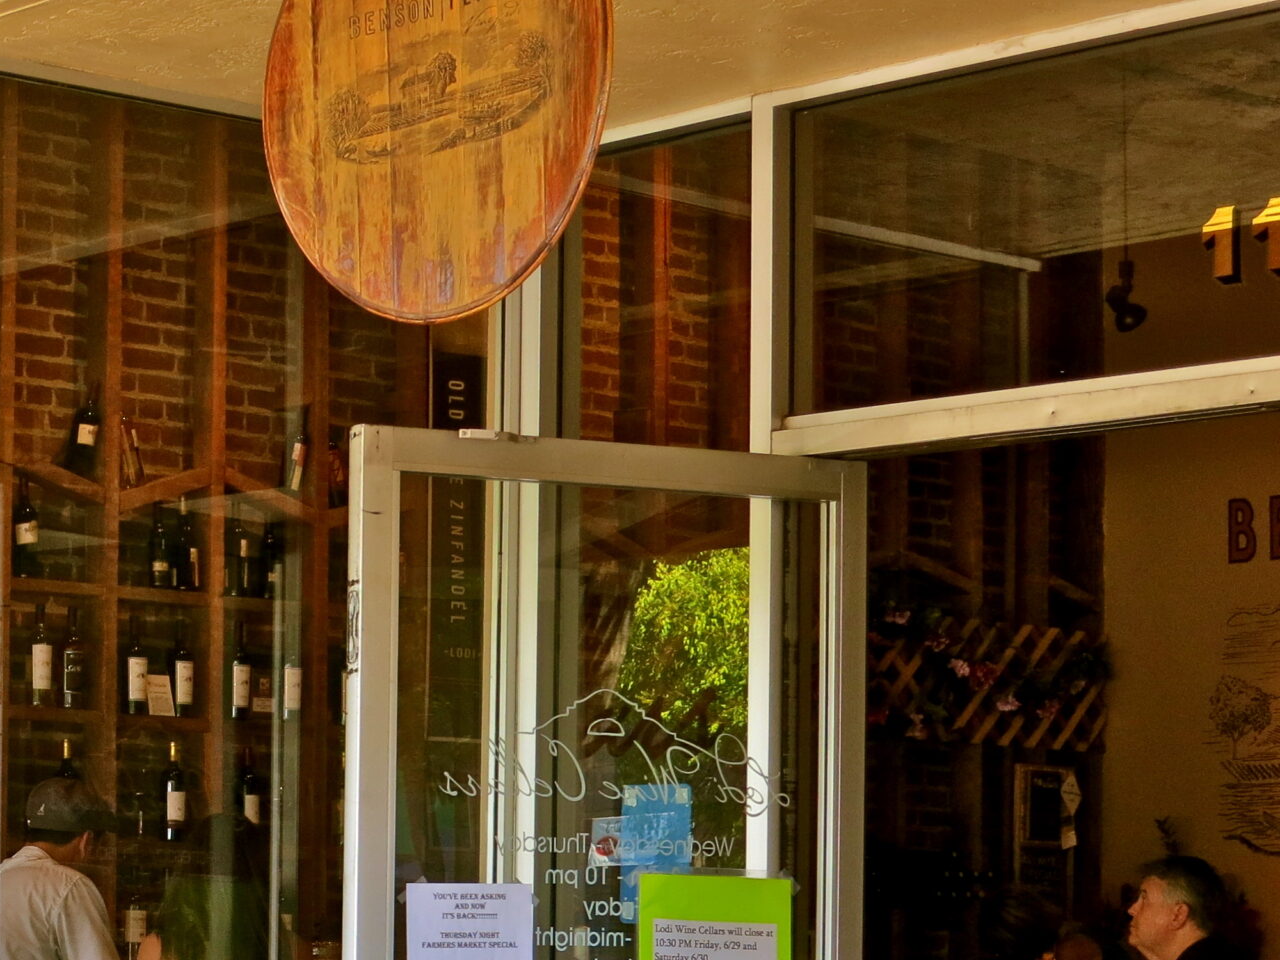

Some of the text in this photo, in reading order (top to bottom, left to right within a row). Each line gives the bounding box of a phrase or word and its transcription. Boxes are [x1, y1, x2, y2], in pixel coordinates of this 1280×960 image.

[348, 0, 435, 40] BENSON
[448, 379, 465, 421] OLD
[449, 500, 466, 624] ZINFANDEL
[433, 892, 507, 901] YOU'VE BEEN ASKING
[442, 912, 455, 920] IT'S
[655, 924, 773, 938] Lodi Wine Cellars will close at
[422, 941, 518, 949] FARMERS MARKET SPECIAL
[655, 938, 758, 951] 10:30 PM Friday, 6/29 and
